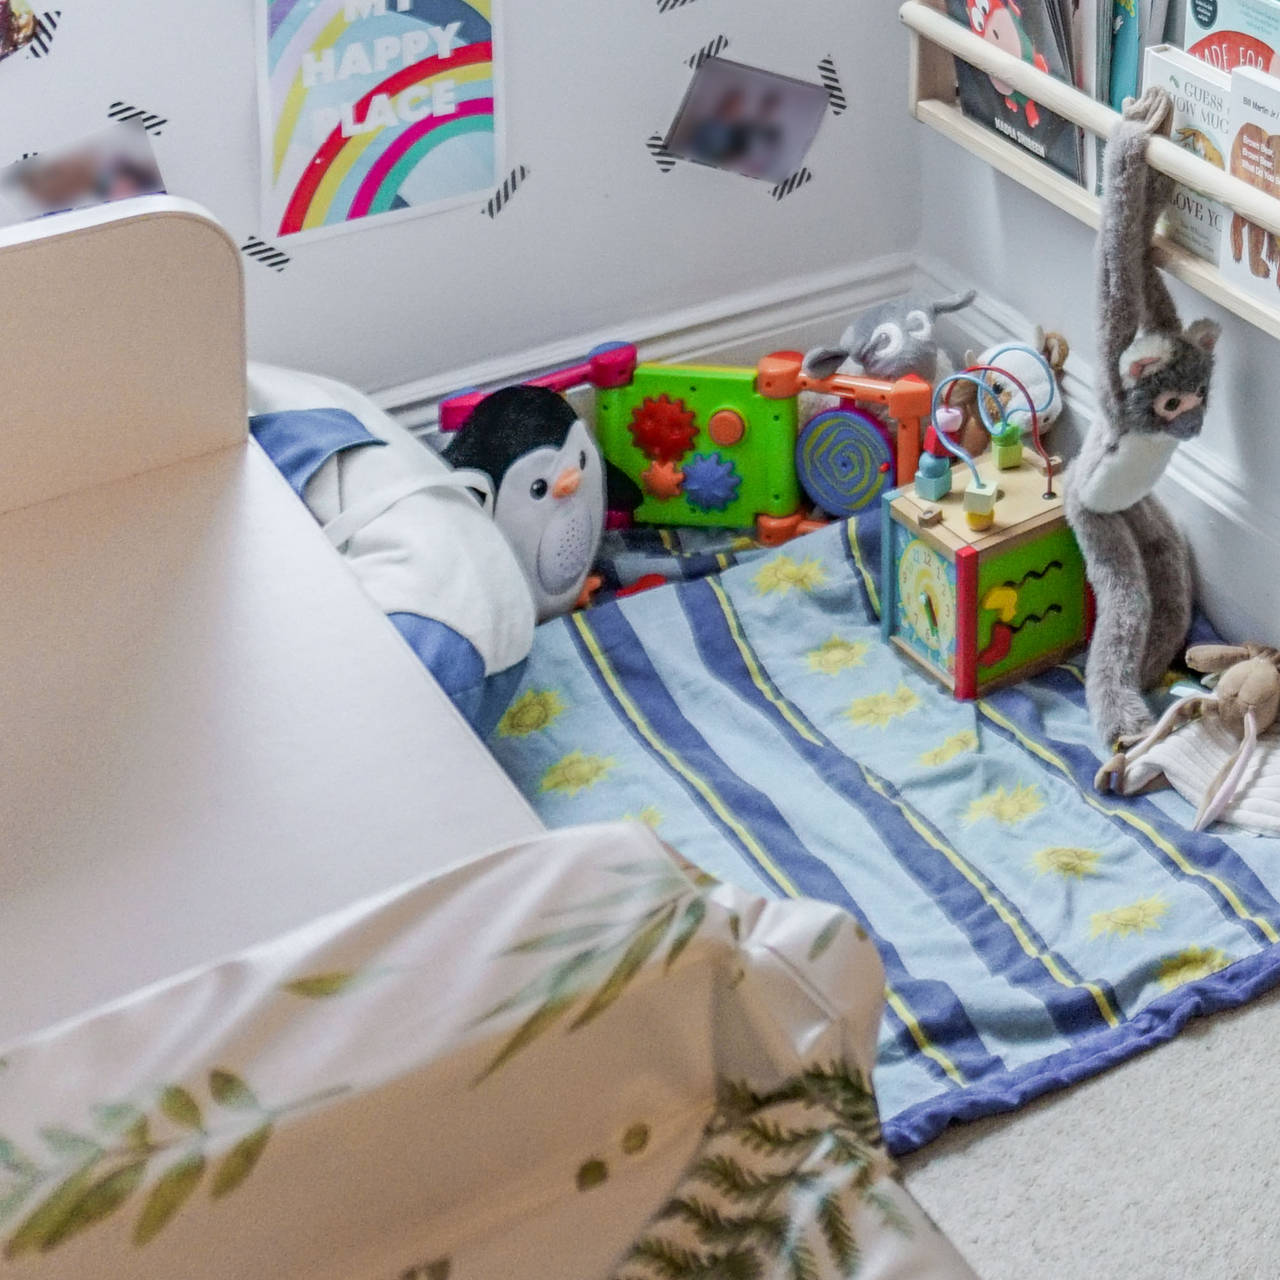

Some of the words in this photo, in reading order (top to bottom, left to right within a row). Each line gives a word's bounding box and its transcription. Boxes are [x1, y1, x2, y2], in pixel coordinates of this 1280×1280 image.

[302, 22, 461, 88] HAPPY
[1195, 44, 1229, 73] ADE
[313, 79, 457, 145] PLACE
[1201, 108, 1229, 134] MUC
